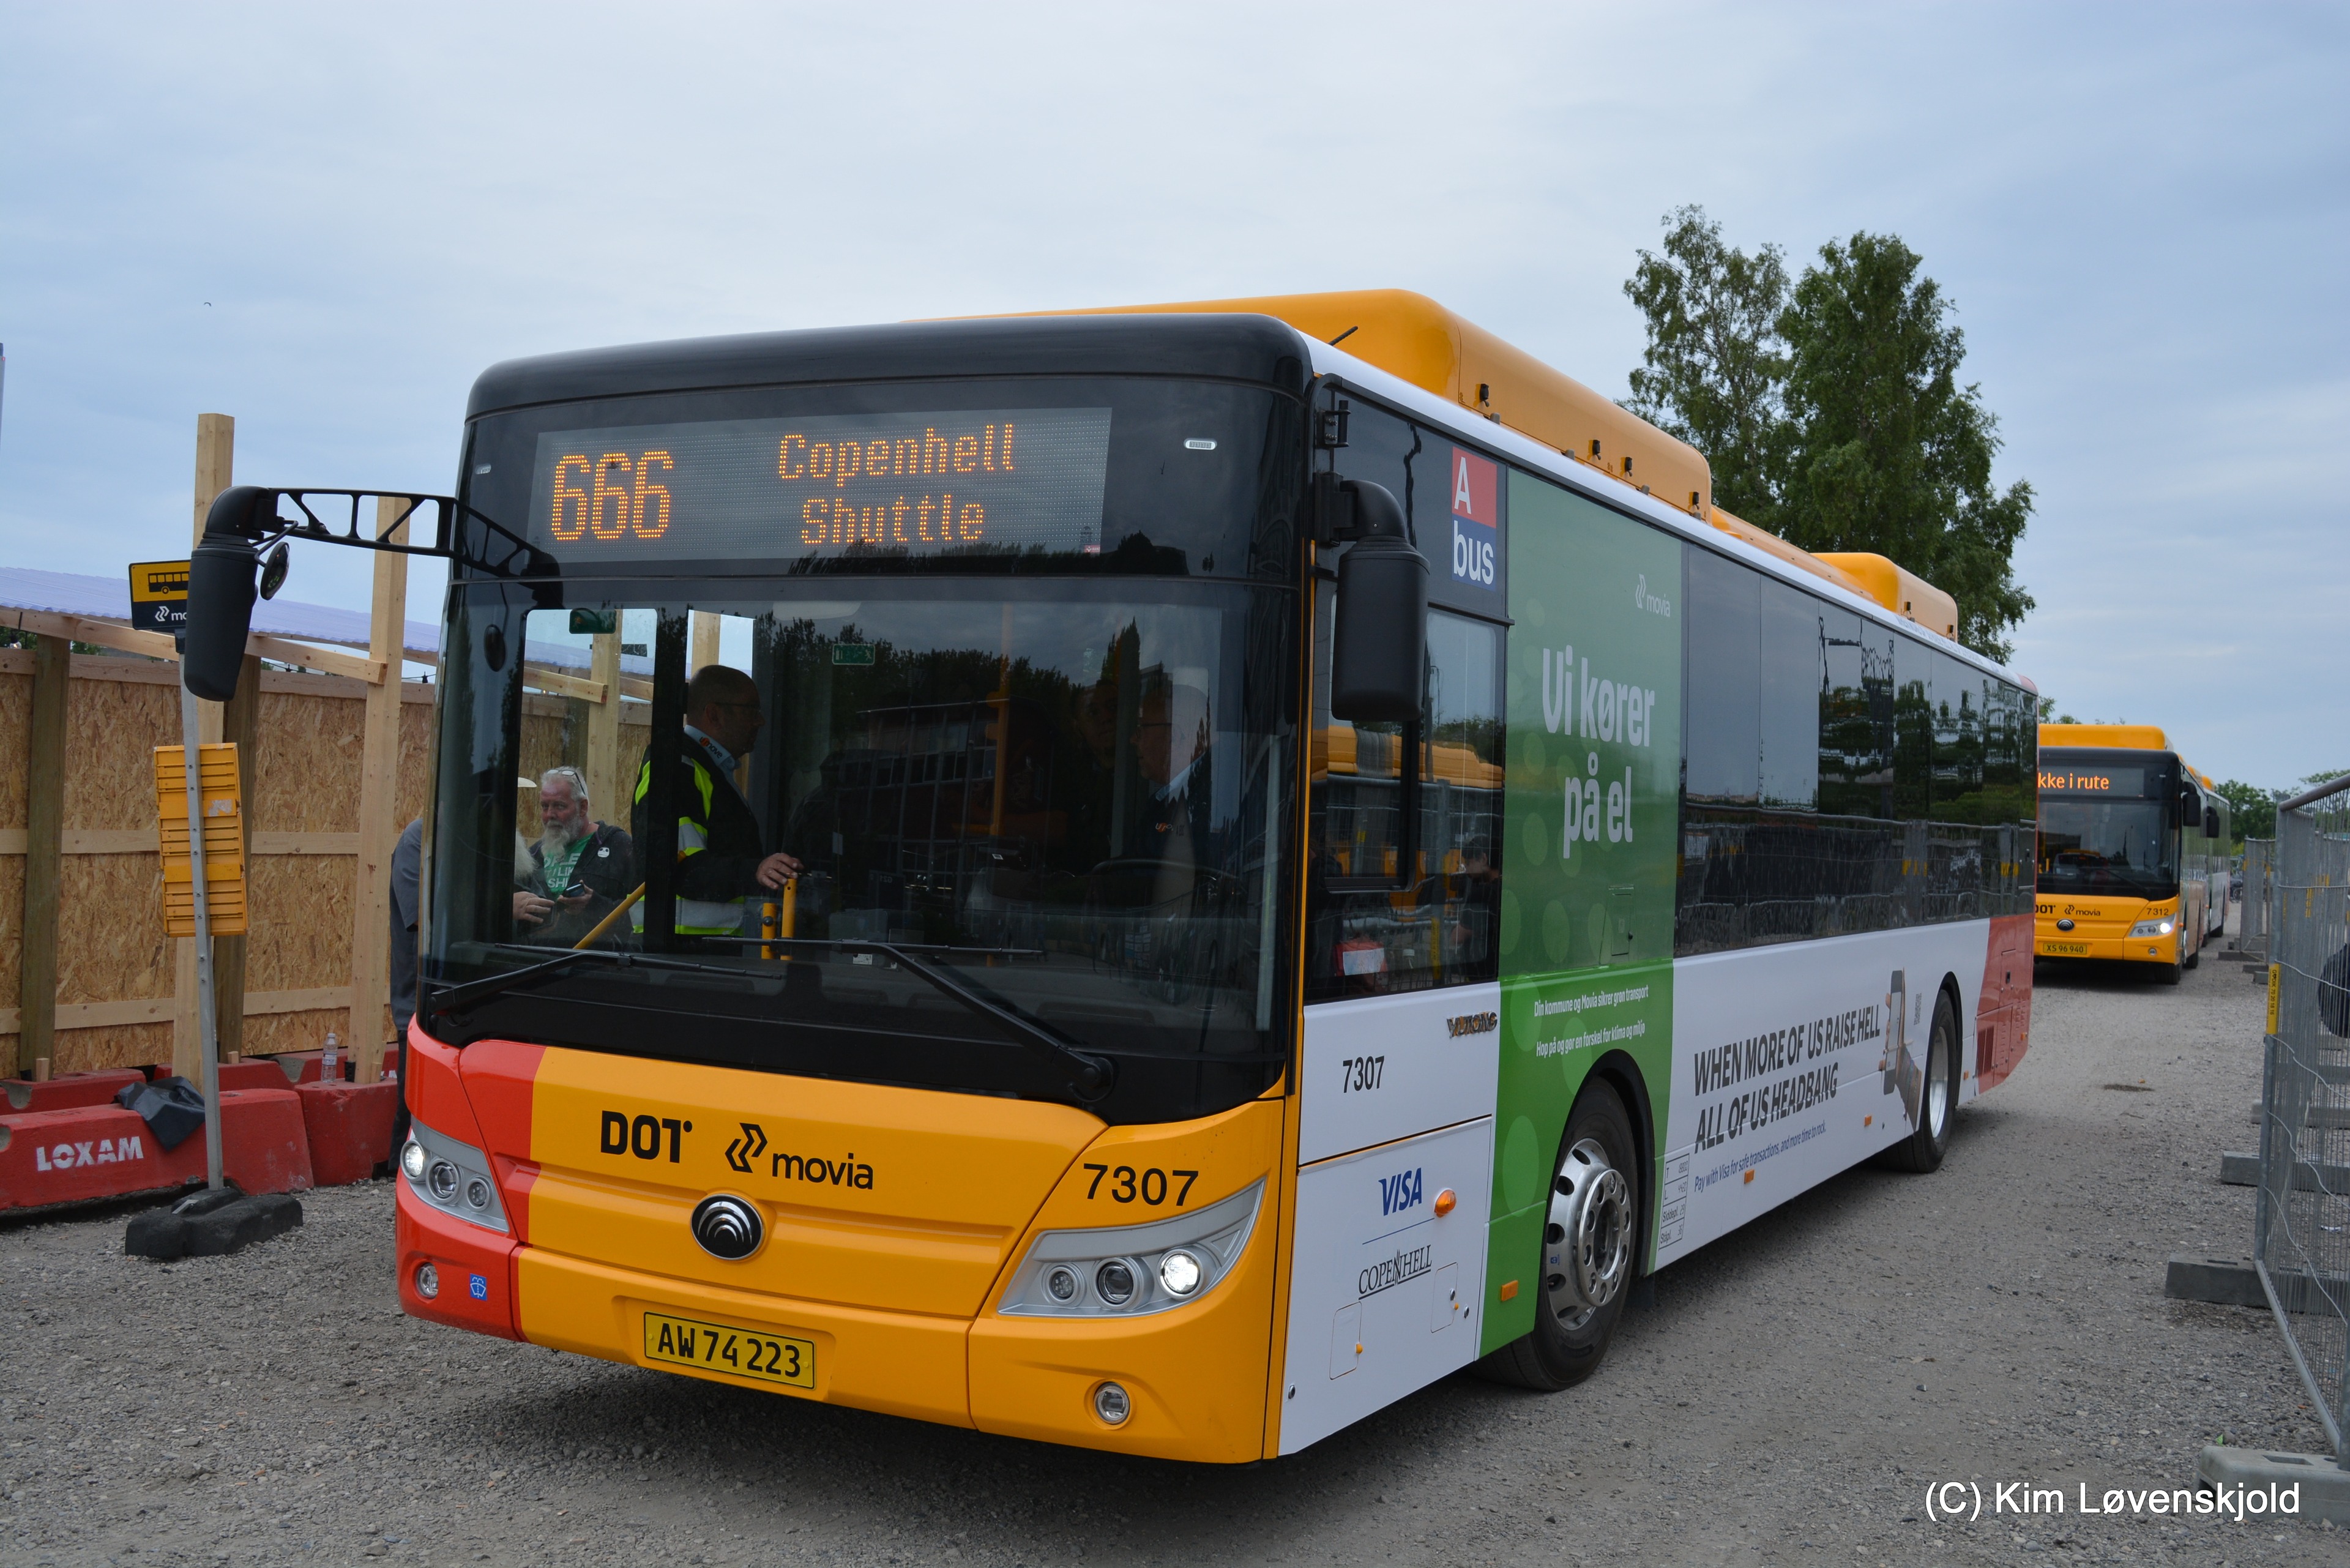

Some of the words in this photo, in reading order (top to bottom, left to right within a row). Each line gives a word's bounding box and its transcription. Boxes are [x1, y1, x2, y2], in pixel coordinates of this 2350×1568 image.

[778, 422, 1015, 487] Copenhell
[551, 450, 674, 541] 666
[1453, 456, 1472, 515] A
[800, 493, 986, 545] Shuttle
[1453, 520, 1494, 586] bus
[1646, 592, 1671, 618] movia
[1542, 644, 1574, 736] Vi
[1580, 657, 1655, 747] kører
[1563, 752, 1600, 859] på
[1607, 766, 1633, 844] el
[2069, 772, 2073, 789] i
[2077, 775, 2109, 790] rute
[1534, 999, 1544, 1017] Din
[1545, 998, 1573, 1015] kommune
[1573, 998, 1581, 1014] og
[1581, 992, 1597, 1009] Movia
[1598, 990, 1614, 1006] sikrer
[1614, 990, 1625, 1007] grøn
[1626, 985, 1649, 1002] transport
[1536, 1041, 1548, 1058] Hop
[1549, 1037, 1556, 1058] på
[1557, 1040, 1565, 1055] og
[1565, 1039, 1575, 1055] gør
[1575, 1037, 1582, 1048] en
[1583, 1029, 1602, 1047] forskel
[1611, 1025, 1625, 1041] klima
[1626, 1025, 1632, 1040] og
[1633, 1019, 1645, 1037] miljø
[1694, 1041, 1742, 1097] WHEN
[1744, 1029, 1786, 1081] MORE
[1787, 1025, 1804, 1066] OF
[1807, 1018, 1823, 1059] US
[1825, 1010, 1857, 1054] RAISE
[1857, 1004, 1881, 1043] HELL
[1342, 1055, 1385, 1094] 7307
[1695, 1103, 1724, 1154] ALL
[1728, 1093, 1750, 1140] OF
[1750, 1086, 1769, 1130] US
[1770, 1062, 1838, 1123] HEADBANG
[36, 1136, 144, 1171] LOXAM
[600, 1111, 693, 1163] DOT
[1695, 1176, 1704, 1193] Pay
[1706, 1167, 1718, 1187] with
[1719, 1164, 1729, 1181] Visa
[1739, 1153, 1749, 1172] safe
[1750, 1143, 1780, 1167] transactions,
[1780, 1135, 1789, 1152] and
[1789, 1133, 1801, 1146] more
[1801, 1129, 1811, 1143] time
[1811, 1126, 1816, 1139] to
[1816, 1119, 1826, 1137] rock.
[771, 1151, 874, 1191] movia
[1083, 1163, 1199, 1207] 7307
[1378, 1167, 1422, 1216] VISA
[1358, 1244, 1432, 1296] COPENHELL
[658, 1320, 696, 1360] AW
[703, 1328, 738, 1367] 74
[747, 1338, 800, 1378] 223
